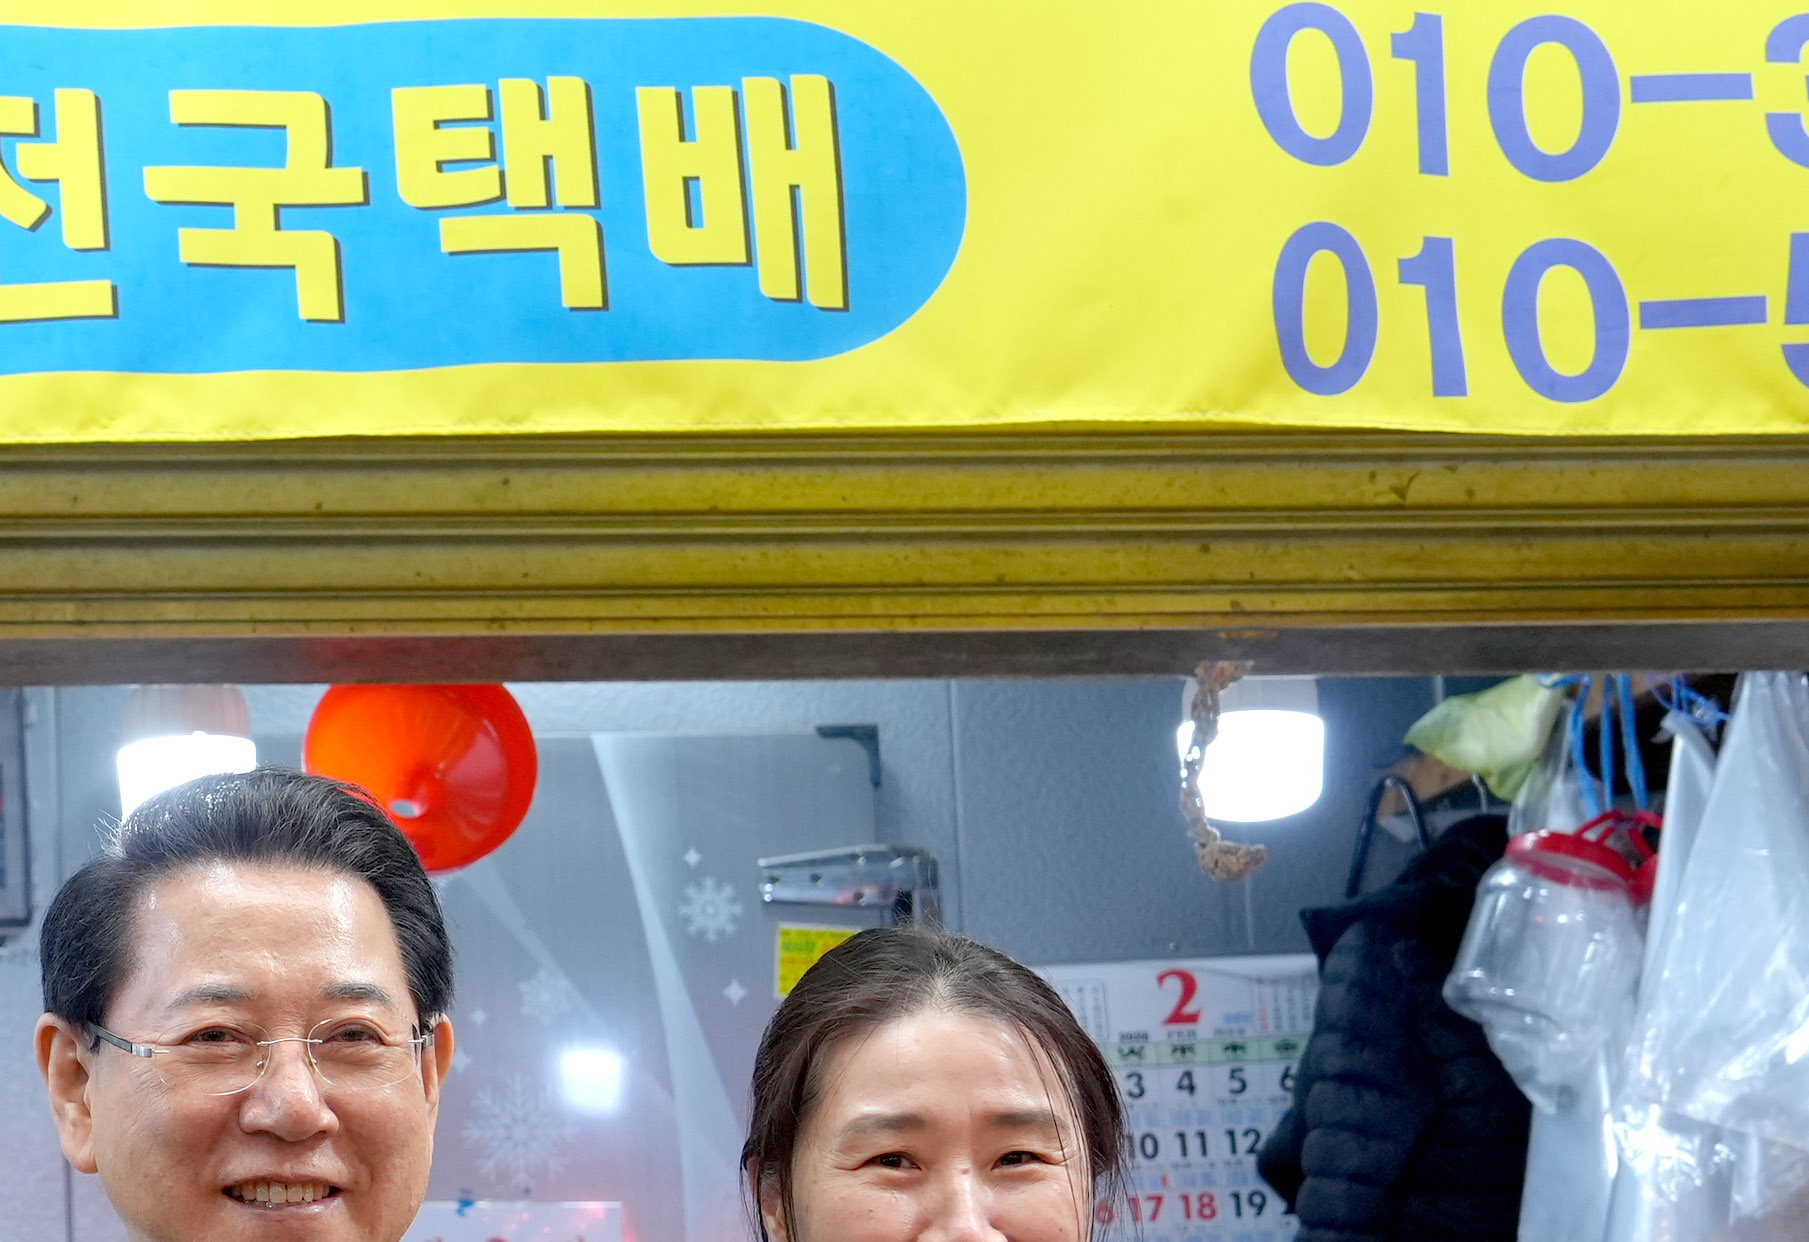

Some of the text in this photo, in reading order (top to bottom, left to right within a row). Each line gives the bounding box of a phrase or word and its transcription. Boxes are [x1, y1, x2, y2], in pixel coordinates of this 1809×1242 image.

[1272, 221, 1809, 403] 010-
[1156, 967, 1201, 1027] 2
[1125, 1065, 1295, 1098] 3 4 5 6
[1175, 1130, 1208, 1157] 11
[1225, 1128, 1261, 1155] 12
[1129, 1192, 1166, 1222] 17
[1179, 1192, 1218, 1220] 18
[1229, 1190, 1267, 1217] 19
